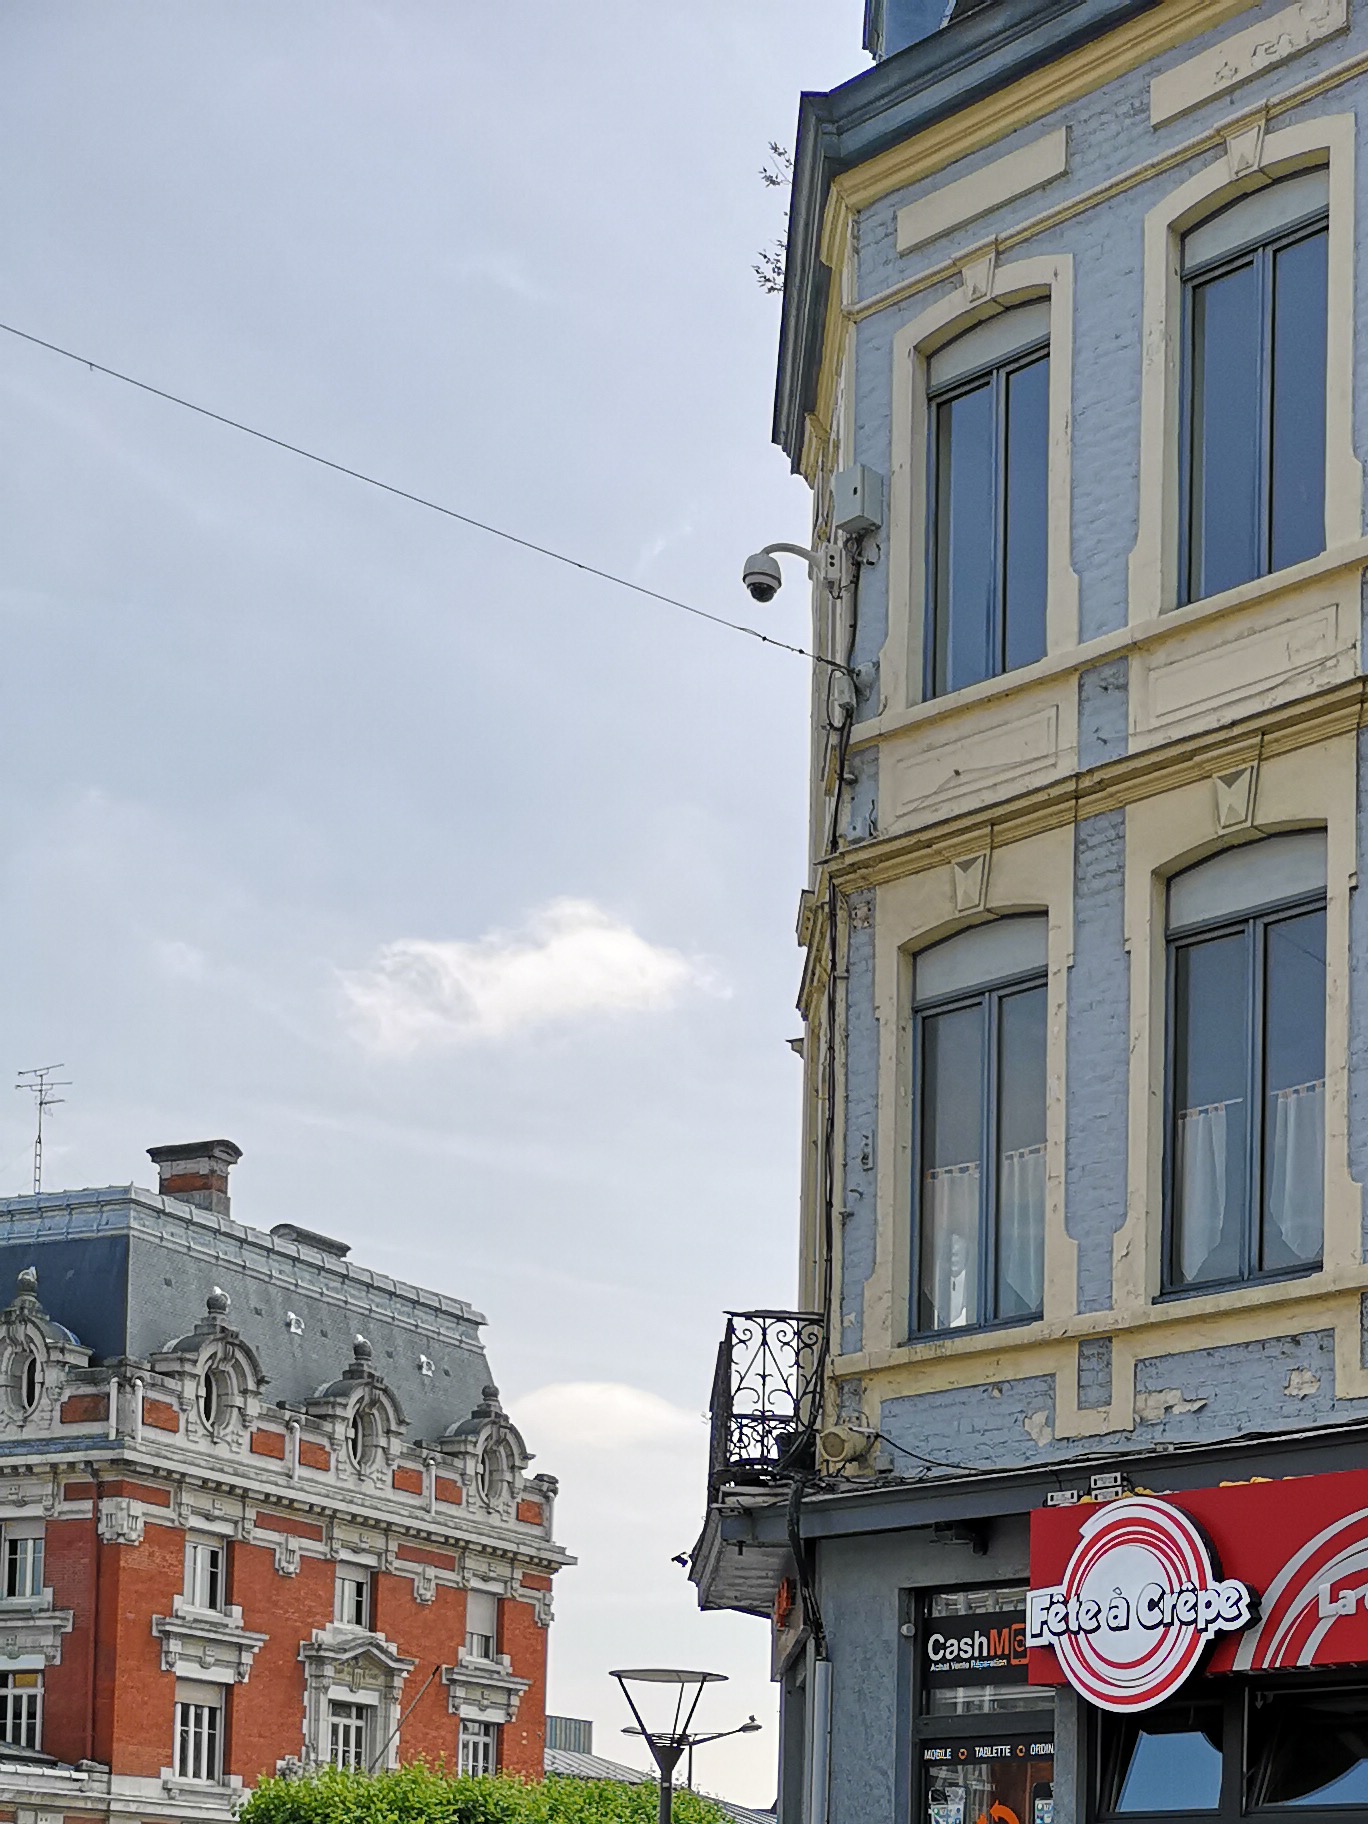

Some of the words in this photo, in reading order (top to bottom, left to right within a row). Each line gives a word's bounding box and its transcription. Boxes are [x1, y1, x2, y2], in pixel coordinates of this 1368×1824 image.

[1030, 1592, 1101, 1638] Fête
[1106, 1586, 1130, 1632] à
[1135, 1580, 1245, 1636] Crêpe
[1318, 1582, 1357, 1619] La
[951, 1660, 970, 1670] Vente
[924, 1748, 952, 1760] MOBILE
[974, 1745, 1012, 1758] TABLETTE
